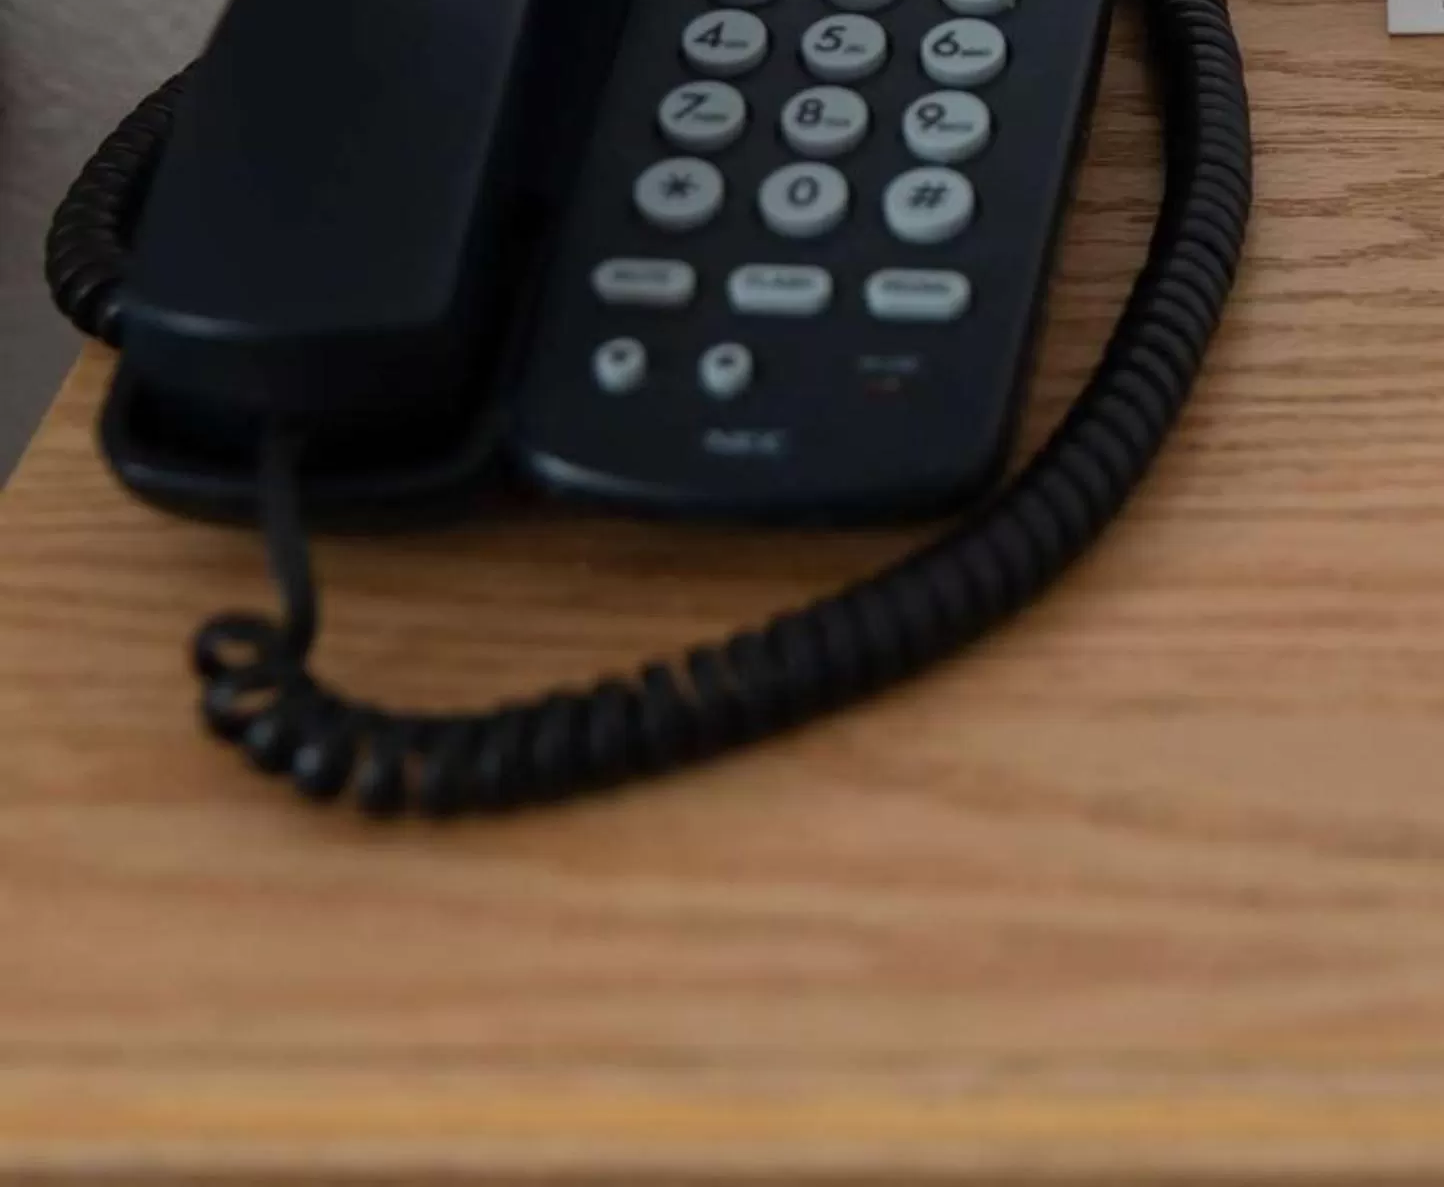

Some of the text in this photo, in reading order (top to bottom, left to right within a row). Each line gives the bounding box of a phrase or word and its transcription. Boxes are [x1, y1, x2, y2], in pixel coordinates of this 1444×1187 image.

[693, 21, 726, 48] 4
[814, 25, 846, 53] 5
[931, 30, 959, 58] 6
[674, 91, 709, 123] 7
[796, 97, 826, 127] 8
[916, 101, 947, 133] 9
[786, 174, 820, 208] 0
